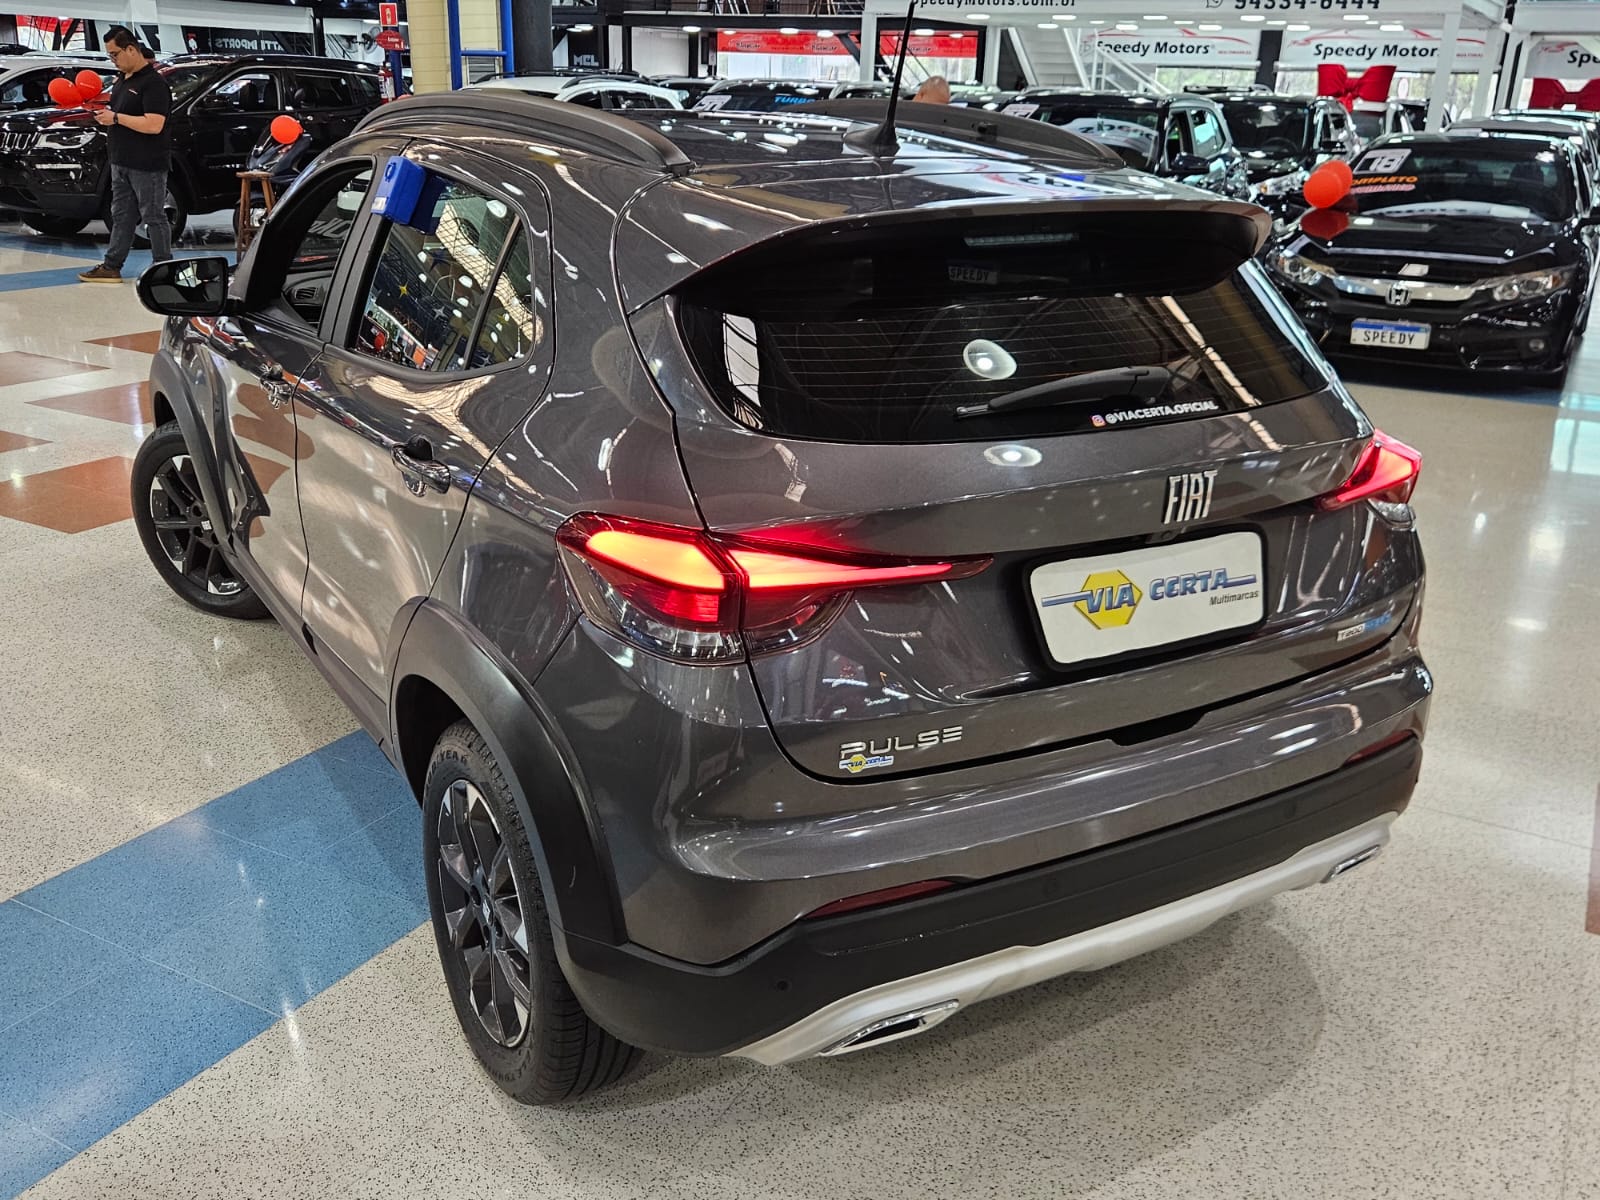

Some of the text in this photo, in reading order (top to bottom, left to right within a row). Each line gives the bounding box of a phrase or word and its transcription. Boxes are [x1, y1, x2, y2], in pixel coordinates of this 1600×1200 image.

[1154, 42, 1210, 54] Motors
[1313, 43, 1441, 60] Speedy Motor
[1351, 176, 1418, 186] OMPLETO
[1363, 330, 1415, 345] SPEEDY
[1105, 400, 1219, 424] @VIACERTA.OFICIAL
[1163, 469, 1218, 524] FIAT
[1084, 568, 1229, 614] VIA CERTA
[1208, 588, 1260, 607] Multimarcas
[840, 725, 963, 760] PULSE
